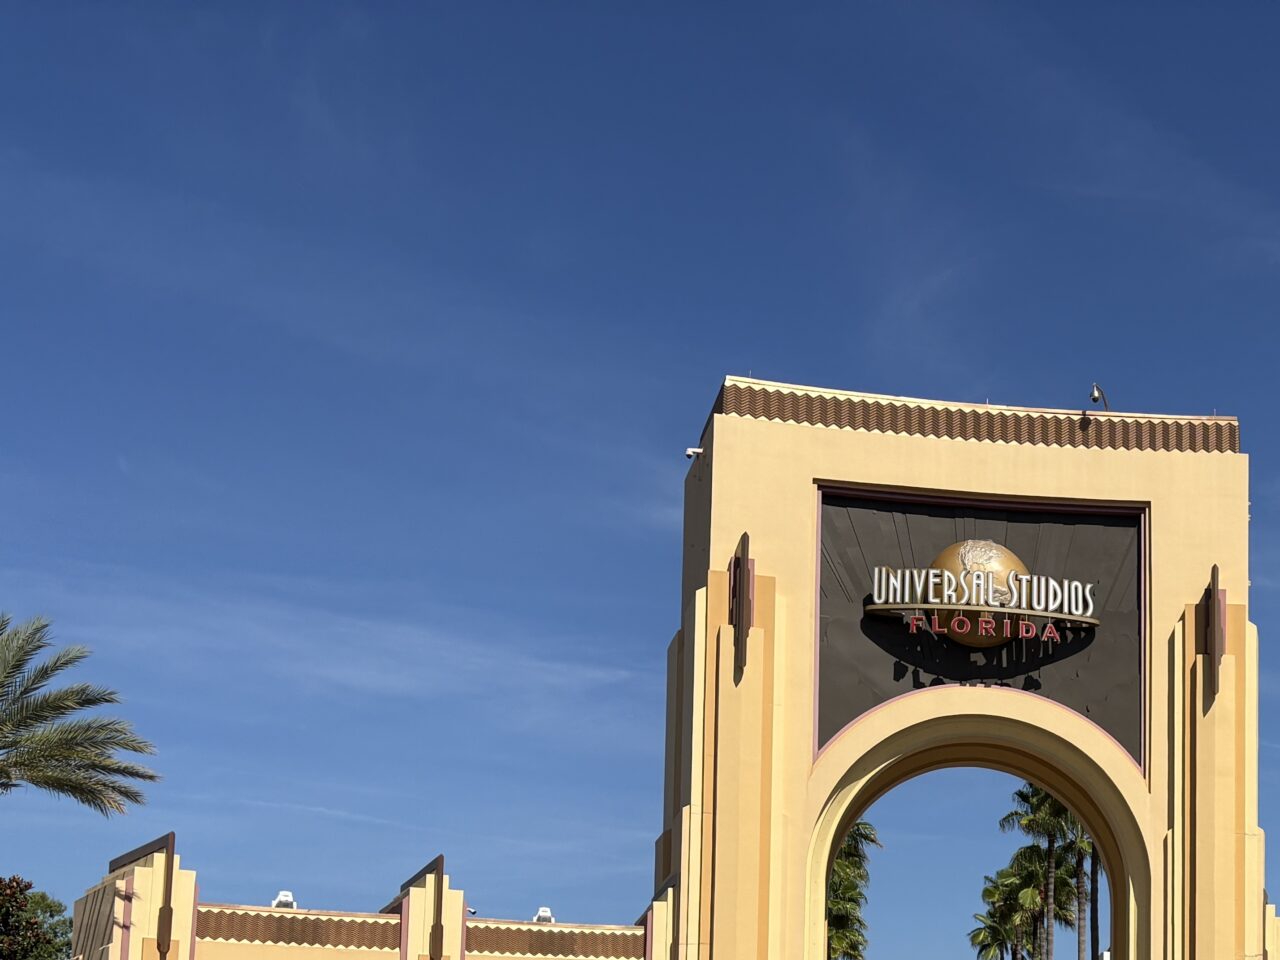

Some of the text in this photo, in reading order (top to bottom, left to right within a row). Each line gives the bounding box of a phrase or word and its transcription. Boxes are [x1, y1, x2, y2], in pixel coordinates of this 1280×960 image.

[873, 566, 1094, 617] UNIVERSAL STUDIOS
[908, 615, 1061, 642] FLORIDA
